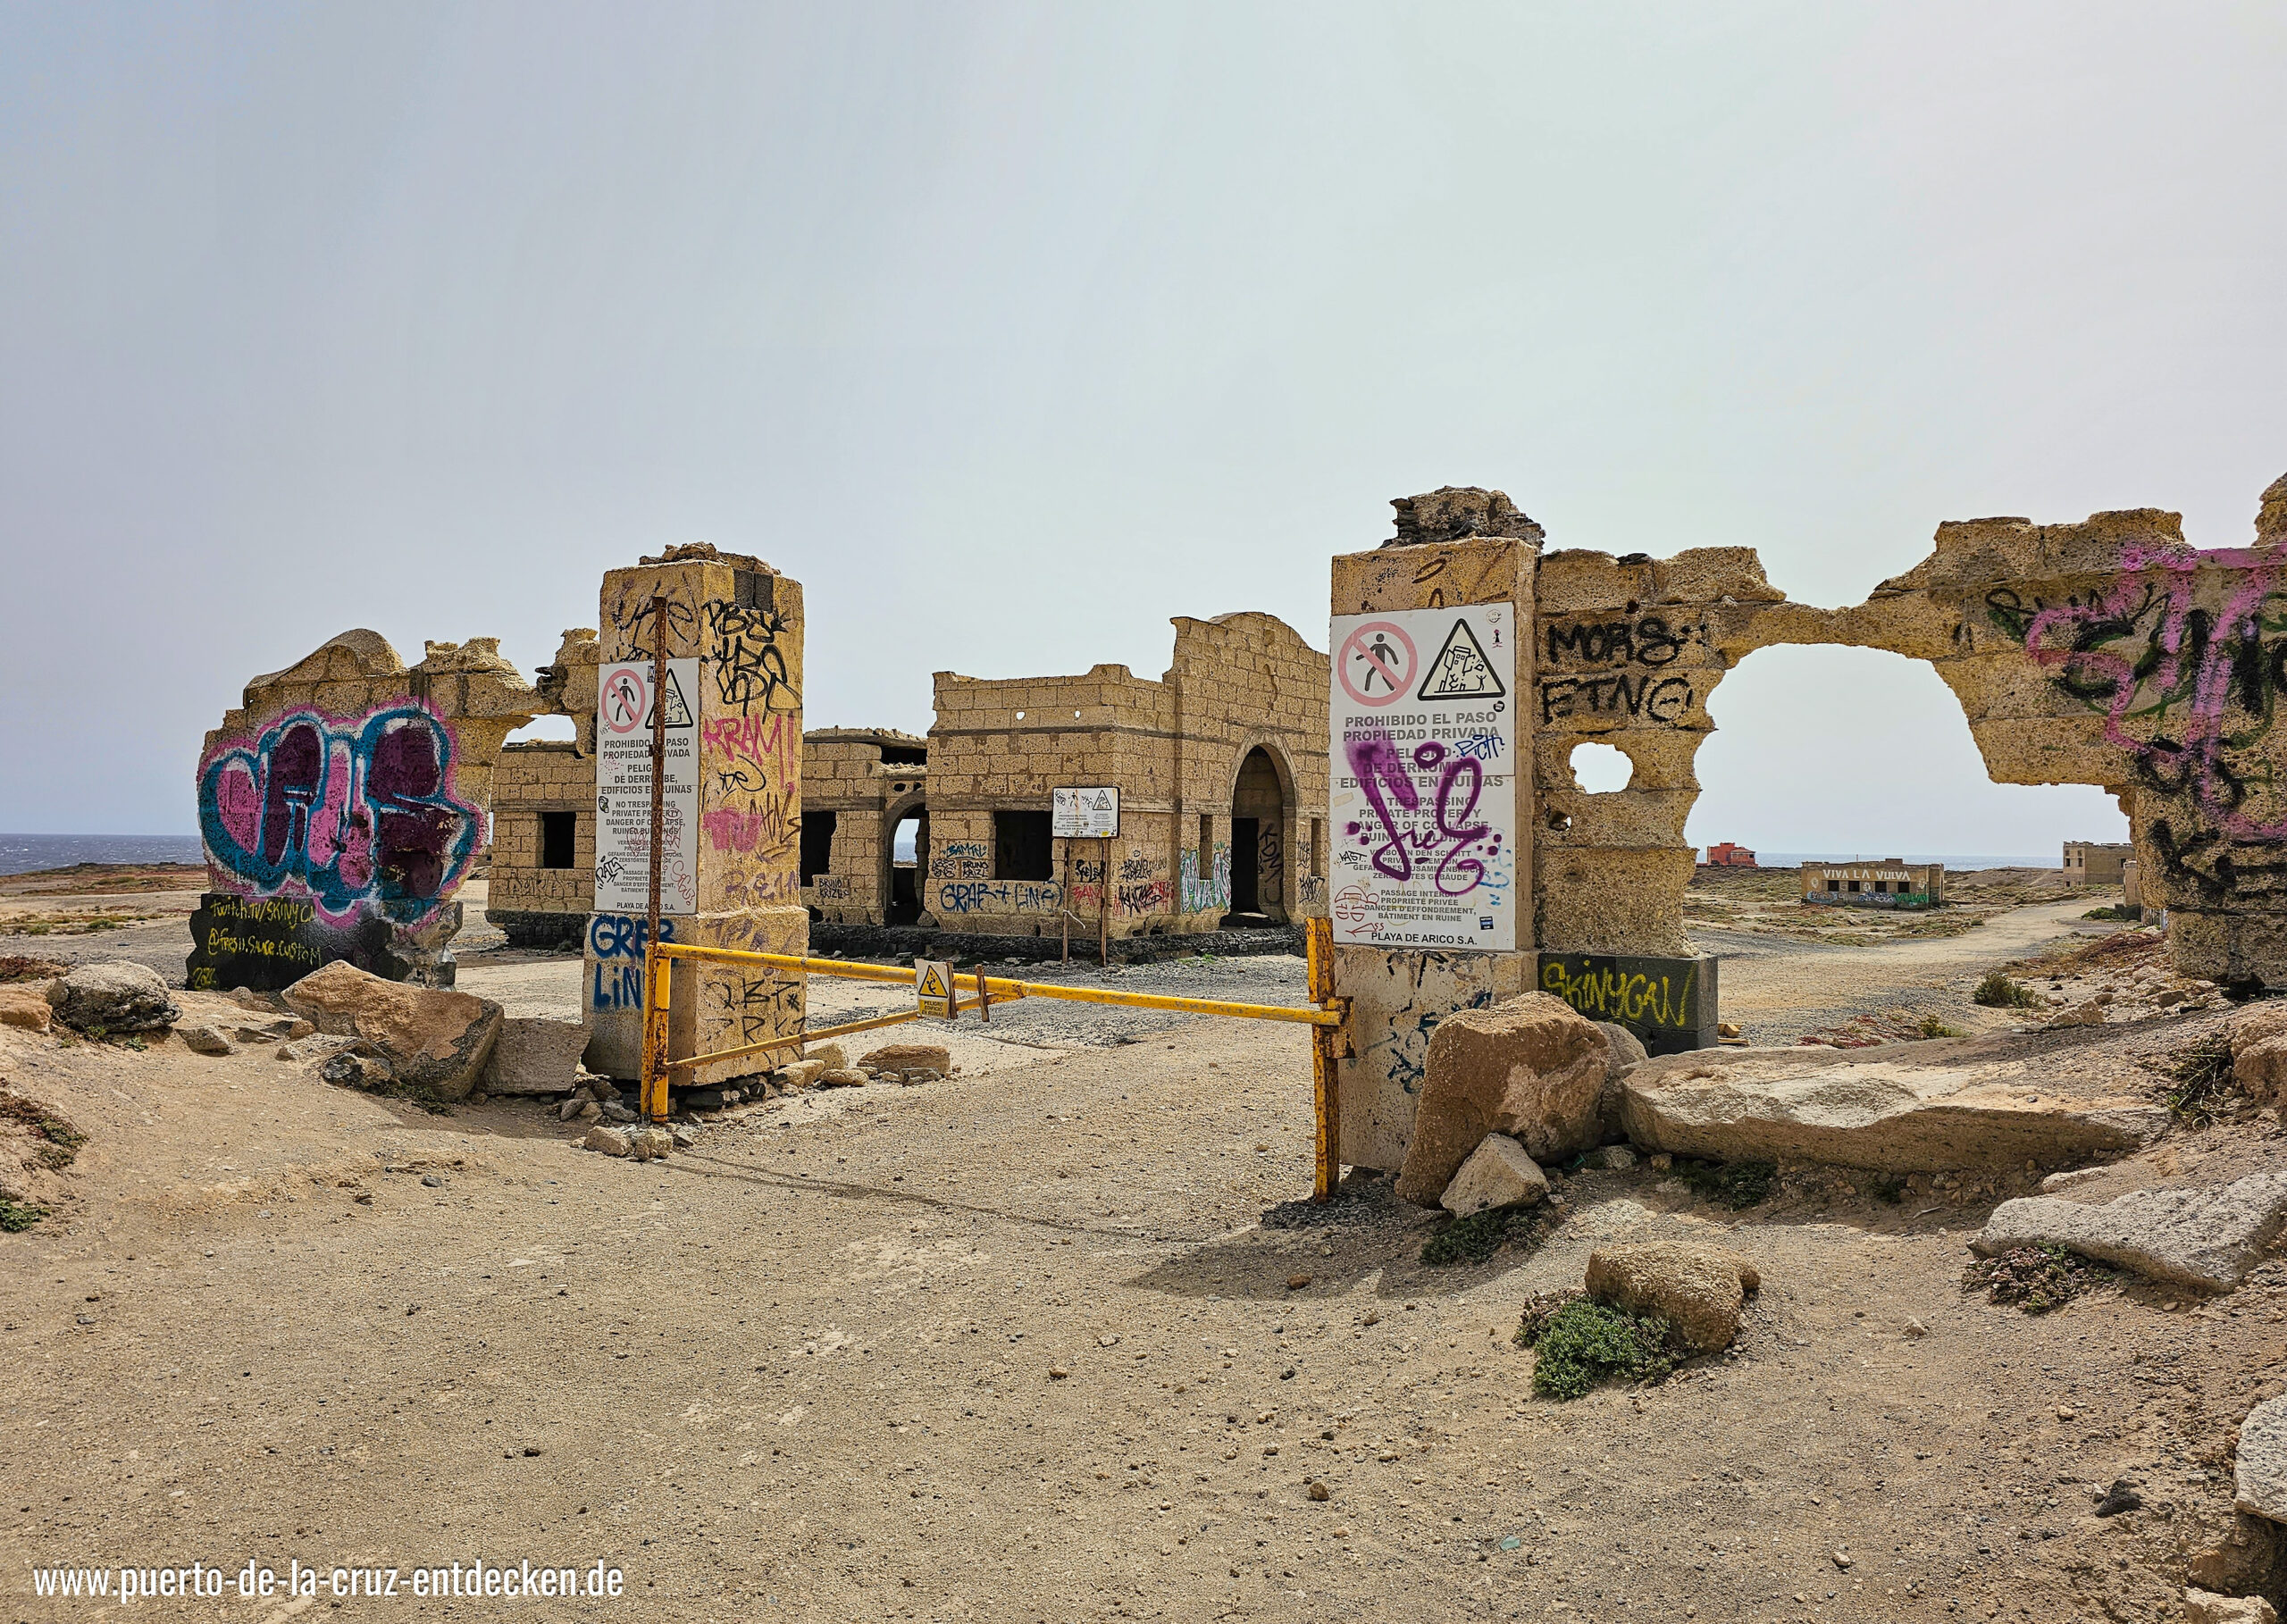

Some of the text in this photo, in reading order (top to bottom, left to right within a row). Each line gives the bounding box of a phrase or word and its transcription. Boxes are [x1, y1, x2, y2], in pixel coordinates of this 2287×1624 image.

[1345, 711, 1497, 727] PROHIBIDO EL PASO
[1343, 726, 1500, 741] PROPIEDAD PRIVADA
[604, 737, 689, 749] PROHIBIDO PASO
[1363, 762, 1382, 774] DE
[615, 774, 625, 783] DE
[1340, 776, 1413, 789] EDIFICIOS
[1419, 776, 1439, 788] EN
[601, 786, 642, 794] EDIFICIOS
[616, 800, 625, 808] NO
[1366, 797, 1383, 807] NO
[612, 809, 641, 817] PRIVATE
[606, 818, 634, 826] DANGER
[635, 818, 645, 826] OF
[1403, 821, 1419, 830] OF
[612, 827, 638, 835] RUINED
[1822, 869, 1911, 881] VIVA LA VULVA
[1380, 889, 1417, 897] PASSAGE
[616, 901, 635, 909] PLAYA
[1436, 914, 1462, 922] RUINE
[1371, 932, 1478, 945] PLAYA DE ARICO S.A.
